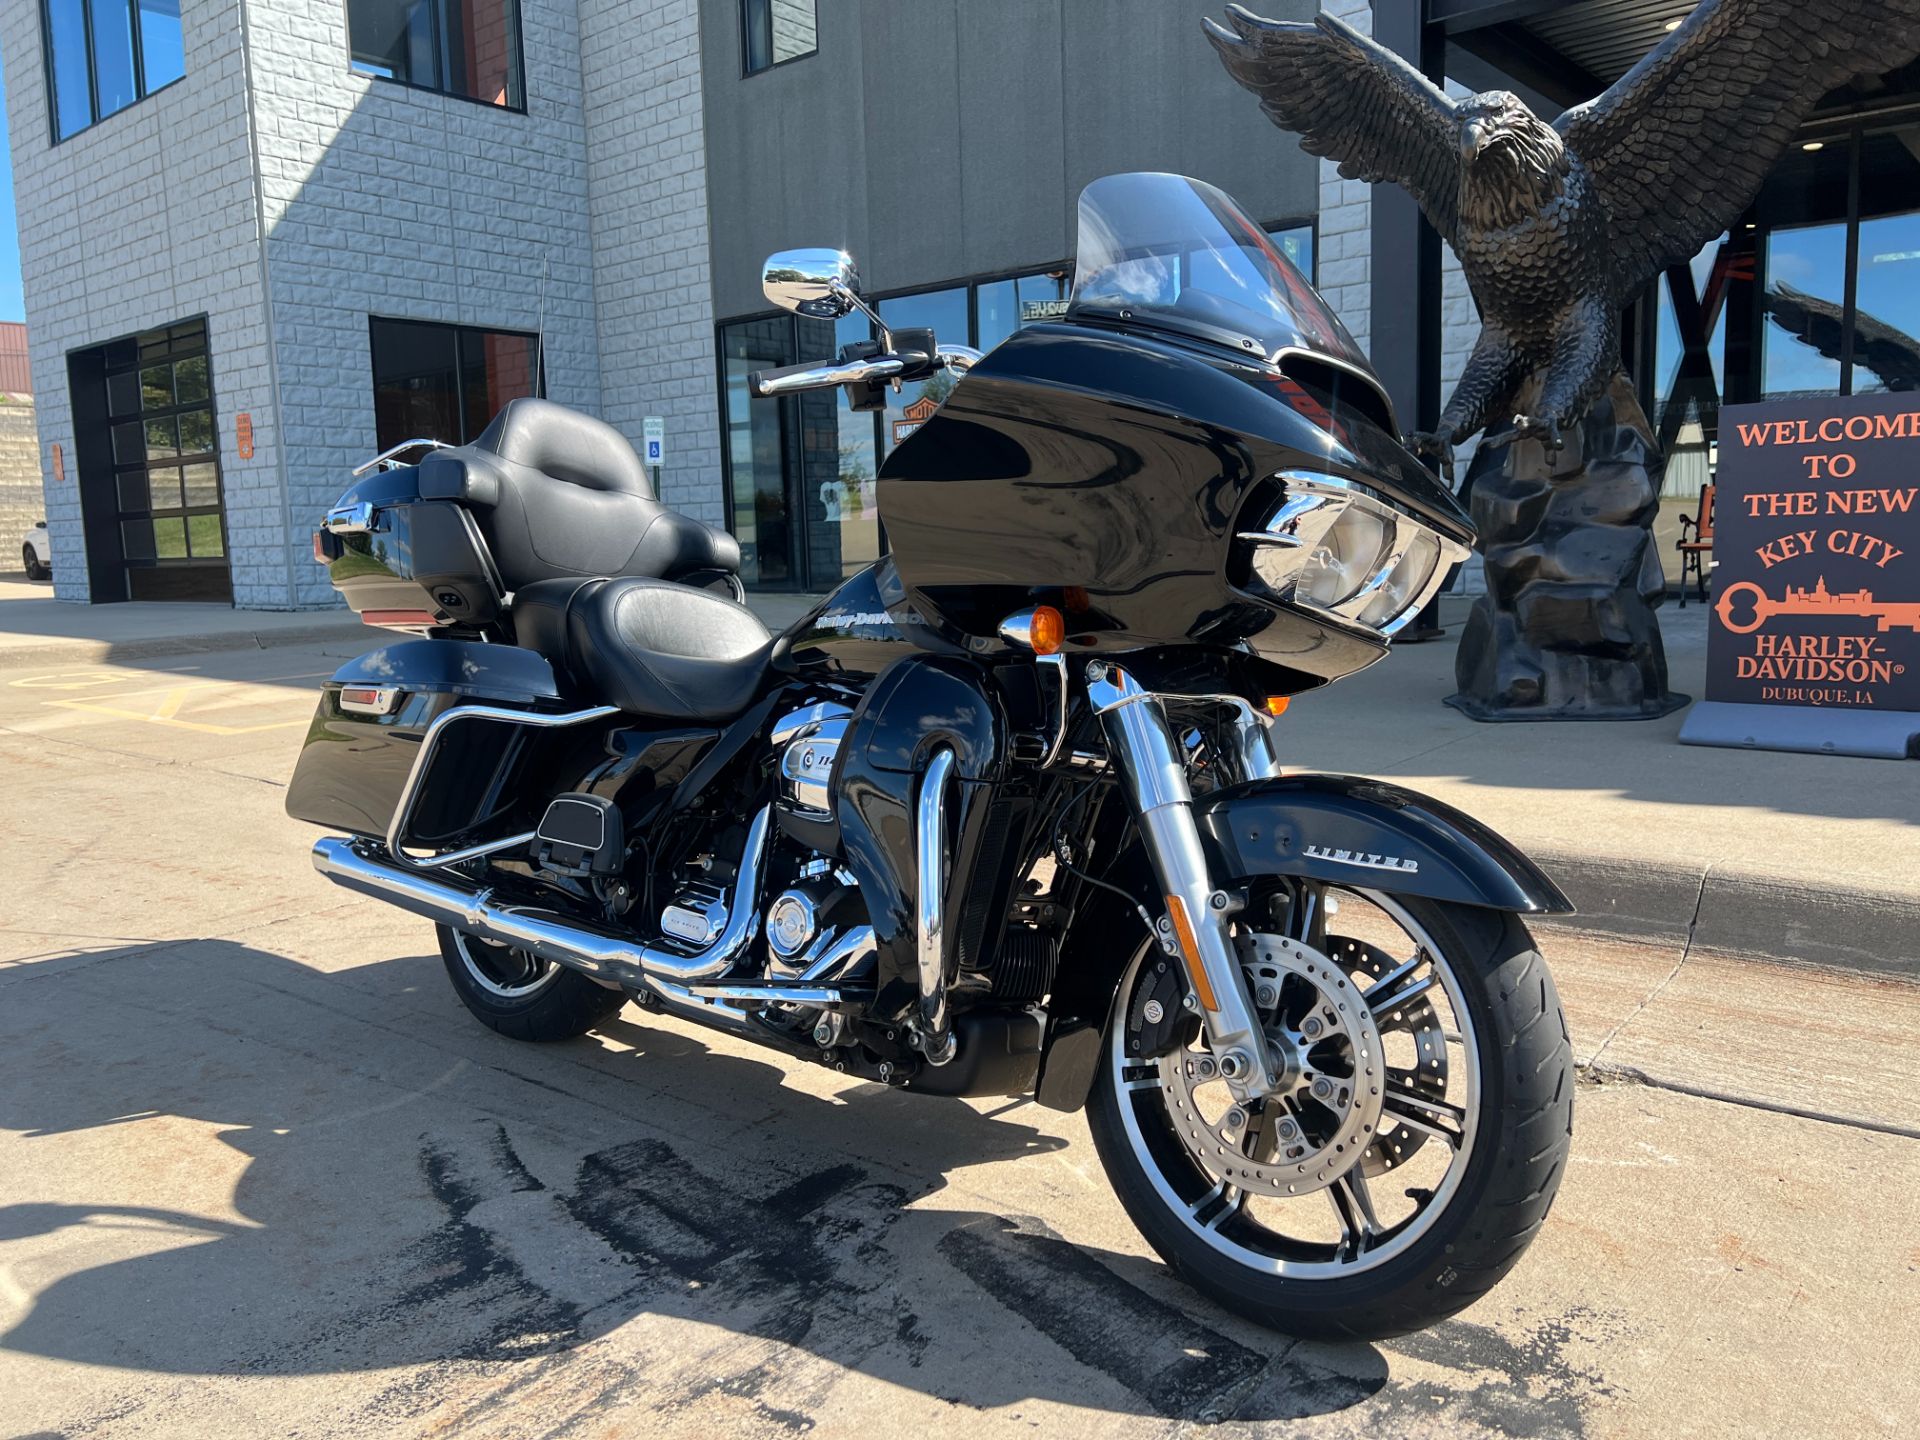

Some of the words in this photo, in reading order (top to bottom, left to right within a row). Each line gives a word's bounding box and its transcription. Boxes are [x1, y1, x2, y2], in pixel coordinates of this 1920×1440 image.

[906, 402, 936, 419] MOTO
[1736, 412, 1920, 447] WELCOME
[1803, 454, 1857, 479] TO
[1743, 492, 1818, 517] THE
[1825, 488, 1918, 515] NEW
[1755, 530, 1817, 569] KEY
[1827, 529, 1904, 569] CITY
[1755, 634, 1887, 659] HARLEY-
[1761, 687, 1852, 705] DUBUQUE,
[1855, 690, 1874, 704] IA
[1304, 845, 1418, 872] LIMITED
